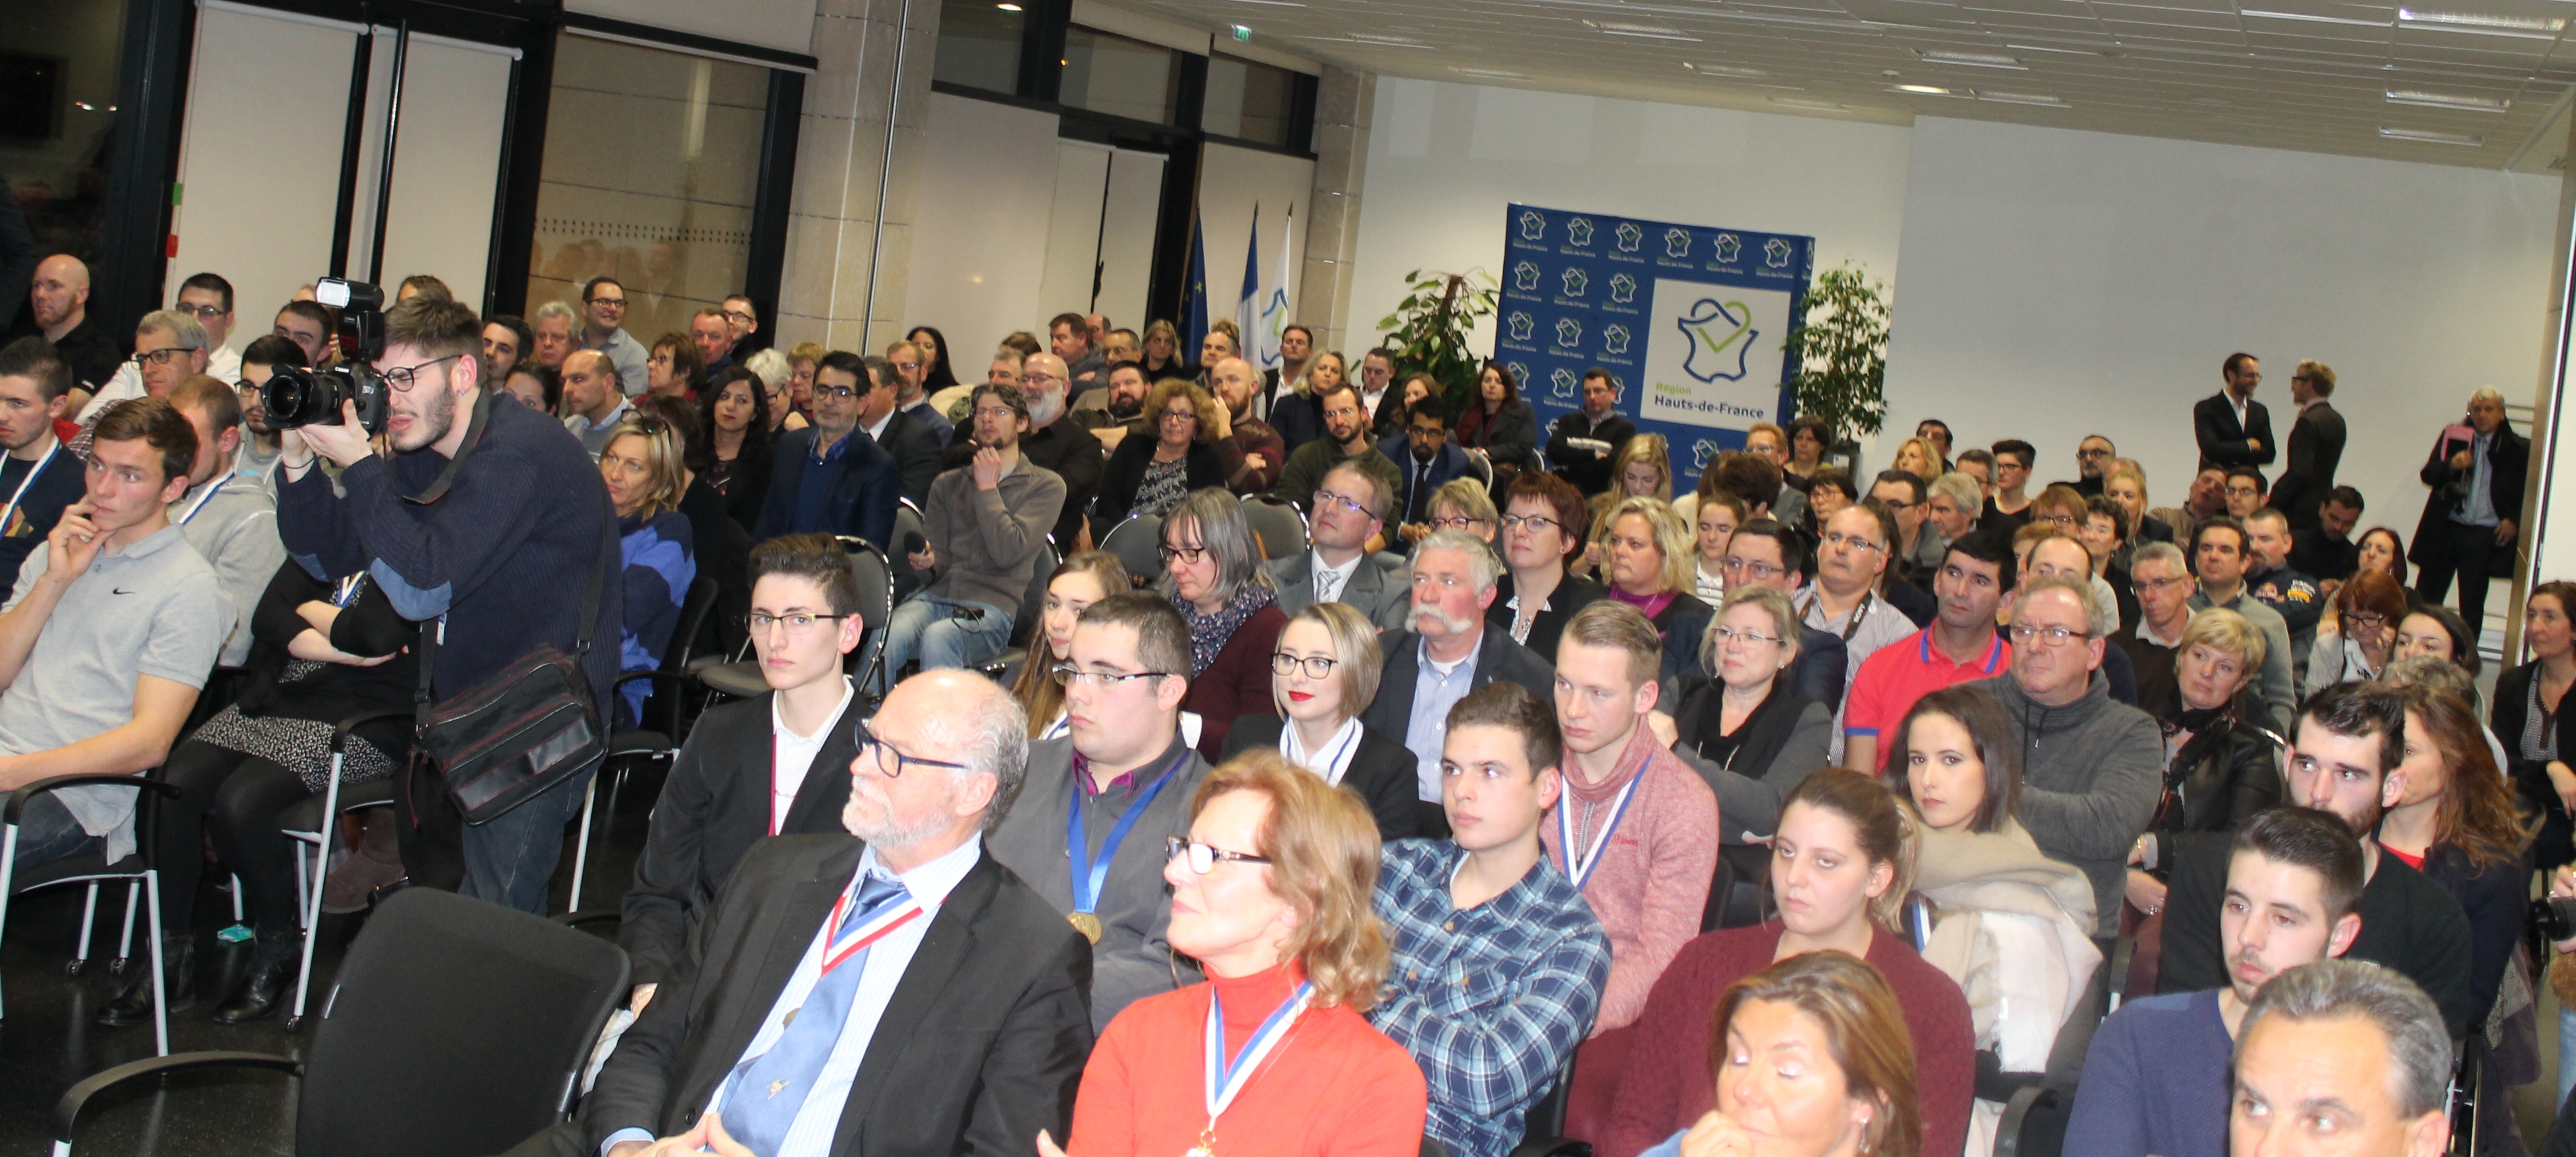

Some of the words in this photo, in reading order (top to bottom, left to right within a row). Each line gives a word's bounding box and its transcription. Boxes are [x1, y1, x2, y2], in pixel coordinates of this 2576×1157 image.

[1655, 382, 1692, 395] Région
[1655, 394, 1764, 418] Hauts-de-France
[1853, 602, 1866, 623] SONY
